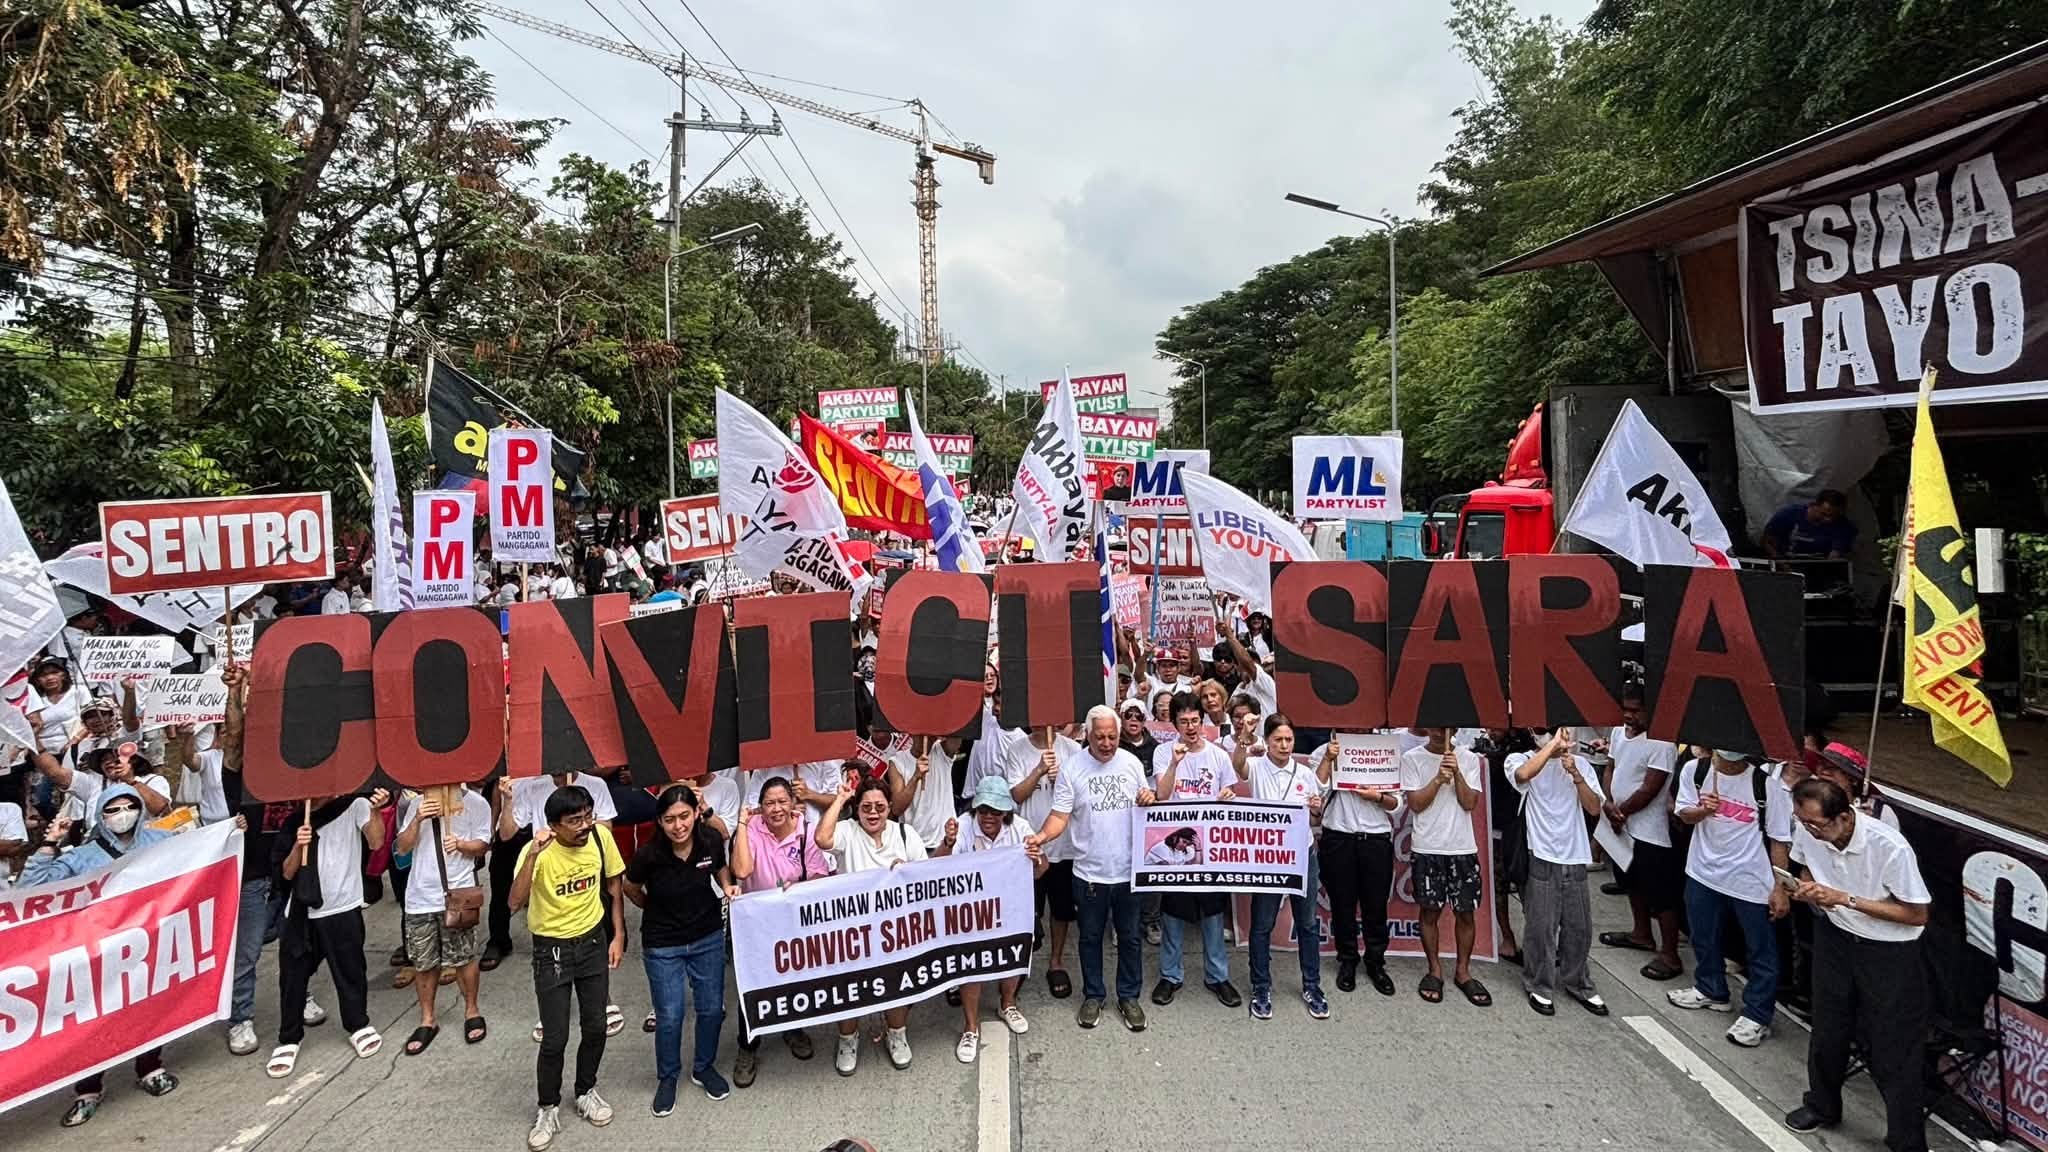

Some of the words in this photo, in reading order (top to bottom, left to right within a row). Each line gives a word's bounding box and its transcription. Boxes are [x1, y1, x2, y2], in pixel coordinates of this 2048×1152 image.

[1772, 262, 2024, 393] TAYO
[1046, 377, 1124, 401] ABAYAN
[822, 391, 896, 406] AKBAYAN
[822, 404, 895, 421] PARTYLIST
[1080, 415, 1154, 439] BAYAN
[884, 435, 970, 453] AKYAN
[1307, 456, 1386, 496] ML
[1307, 499, 1387, 509] PARTYLIST
[109, 508, 322, 578] SENTRO
[507, 531, 540, 540] PARTIDO
[498, 541, 550, 550] MANGGAGAWA
[1130, 527, 1202, 567] SENT
[427, 583, 460, 593] PARTIDO
[417, 592, 468, 602] MANGGAGAWA
[1154, 623, 1177, 639] ARA
[83, 639, 132, 649] MALINAW
[139, 640, 160, 649] ANG
[1271, 554, 1801, 761] SARA
[151, 678, 205, 694] IMPEACH
[243, 563, 1100, 800] CONVICT
[166, 694, 193, 706] SARA
[195, 692, 226, 707] NOW
[1344, 748, 1382, 756] CONVICT
[1088, 775, 1128, 785] KULONG
[1147, 810, 1199, 823] MALINAW
[1201, 810, 1225, 821] ANG
[1228, 811, 1292, 824] EBIDENSYA
[1209, 827, 1286, 846] CONVICT
[1209, 847, 1249, 863] SARA
[1254, 849, 1296, 865] NOW!
[1148, 873, 1213, 883] PEOPLE'S
[1215, 874, 1289, 884] ASSEMBLY
[799, 891, 870, 928] MALINAW
[874, 886, 904, 914] ANG
[905, 871, 984, 905] EBIDENSYA
[773, 924, 872, 974] CONVICT
[881, 914, 937, 953] SARA
[944, 896, 1002, 936] NOW!
[0, 897, 216, 1052] SARA!
[757, 976, 886, 1020] PEOPLE'S
[899, 944, 1024, 991] ASSEMBLY
